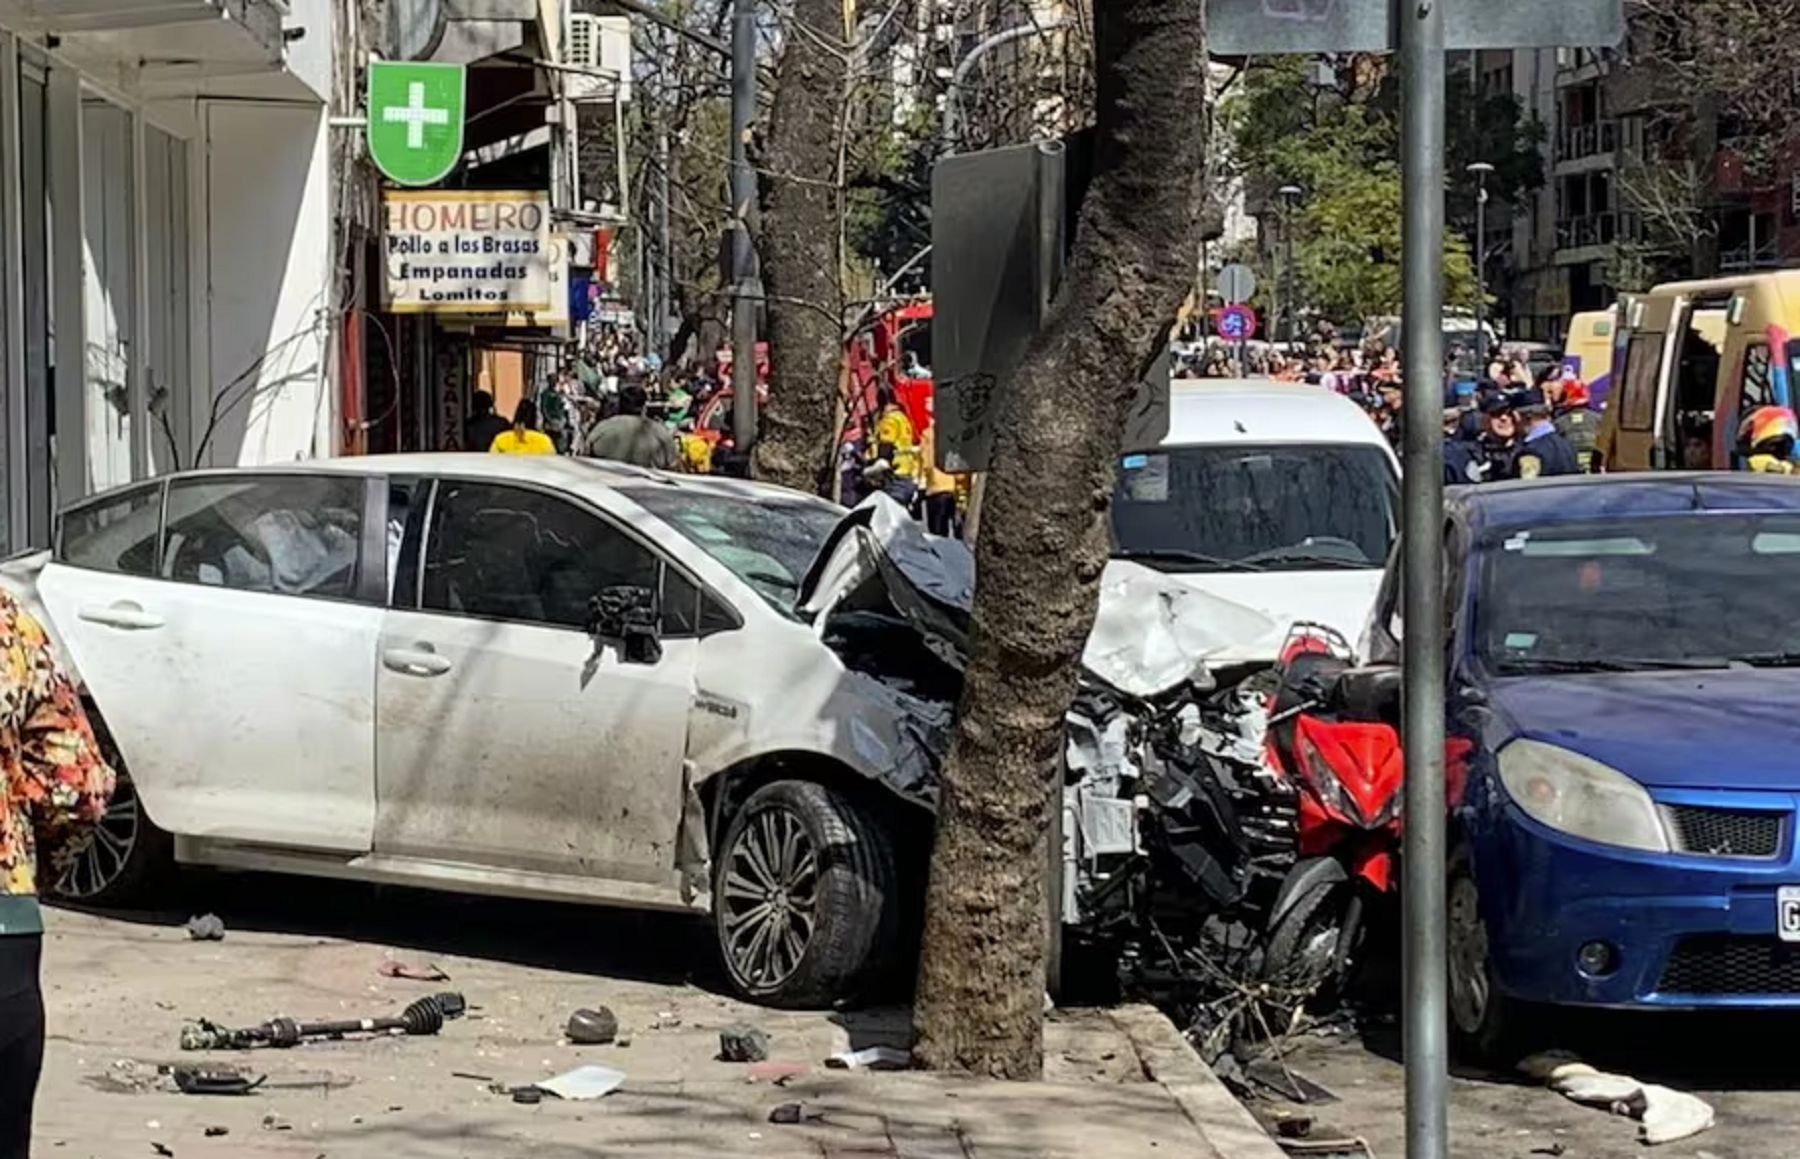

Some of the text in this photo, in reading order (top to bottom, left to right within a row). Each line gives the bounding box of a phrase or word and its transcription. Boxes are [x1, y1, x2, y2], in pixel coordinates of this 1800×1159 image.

[384, 203, 542, 231] HOMERO
[388, 234, 540, 253] Pollo a las Brasas
[400, 261, 528, 283] Empanadas
[419, 287, 508, 301] Lomitos
